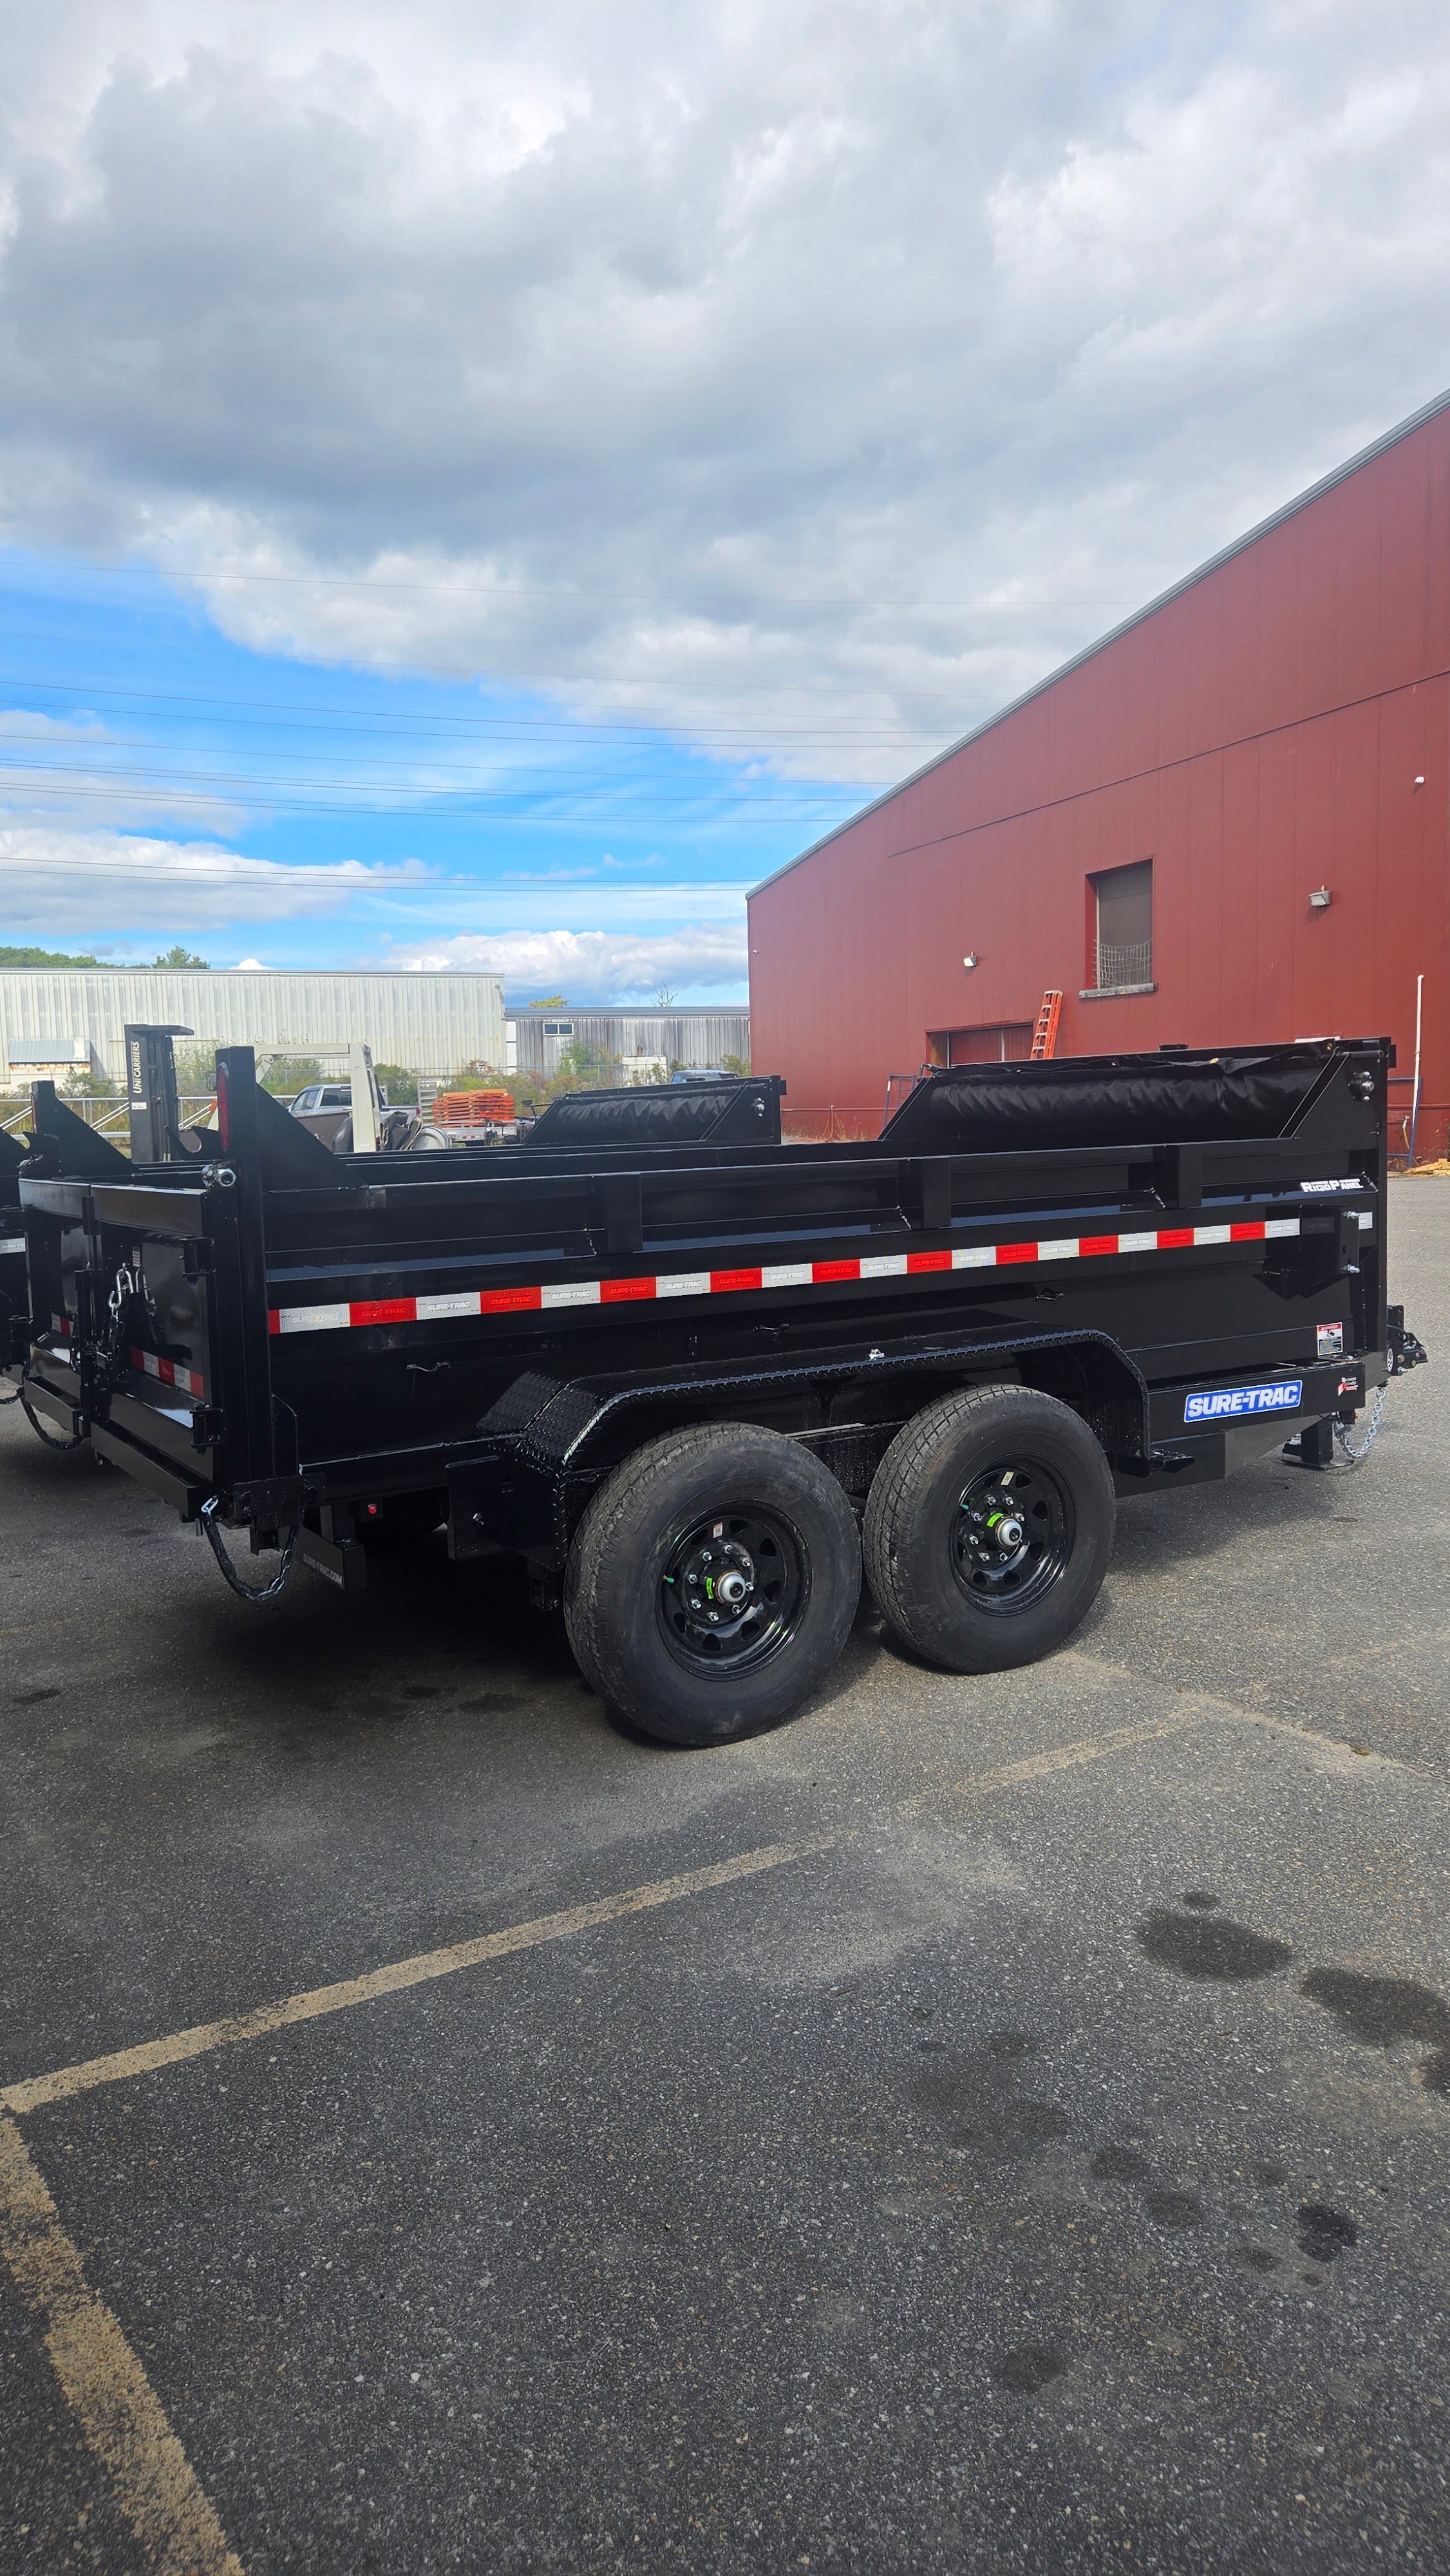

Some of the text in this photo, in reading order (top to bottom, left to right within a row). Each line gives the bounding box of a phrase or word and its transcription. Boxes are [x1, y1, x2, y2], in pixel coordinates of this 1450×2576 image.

[132, 1041, 142, 1094] UNICARRIERS
[665, 1280, 702, 1289] SURE-TRAC
[719, 1276, 754, 1285] SURE-TRAC
[551, 1290, 591, 1300] SURE-TRAC
[609, 1285, 648, 1295] SURE-TRAC
[490, 1296, 532, 1305] SURE-TRAC
[427, 1302, 470, 1311] SURE-TRAC
[361, 1307, 406, 1317] SURE-TRAC
[1188, 1385, 1299, 1417] SURE-TRAC
